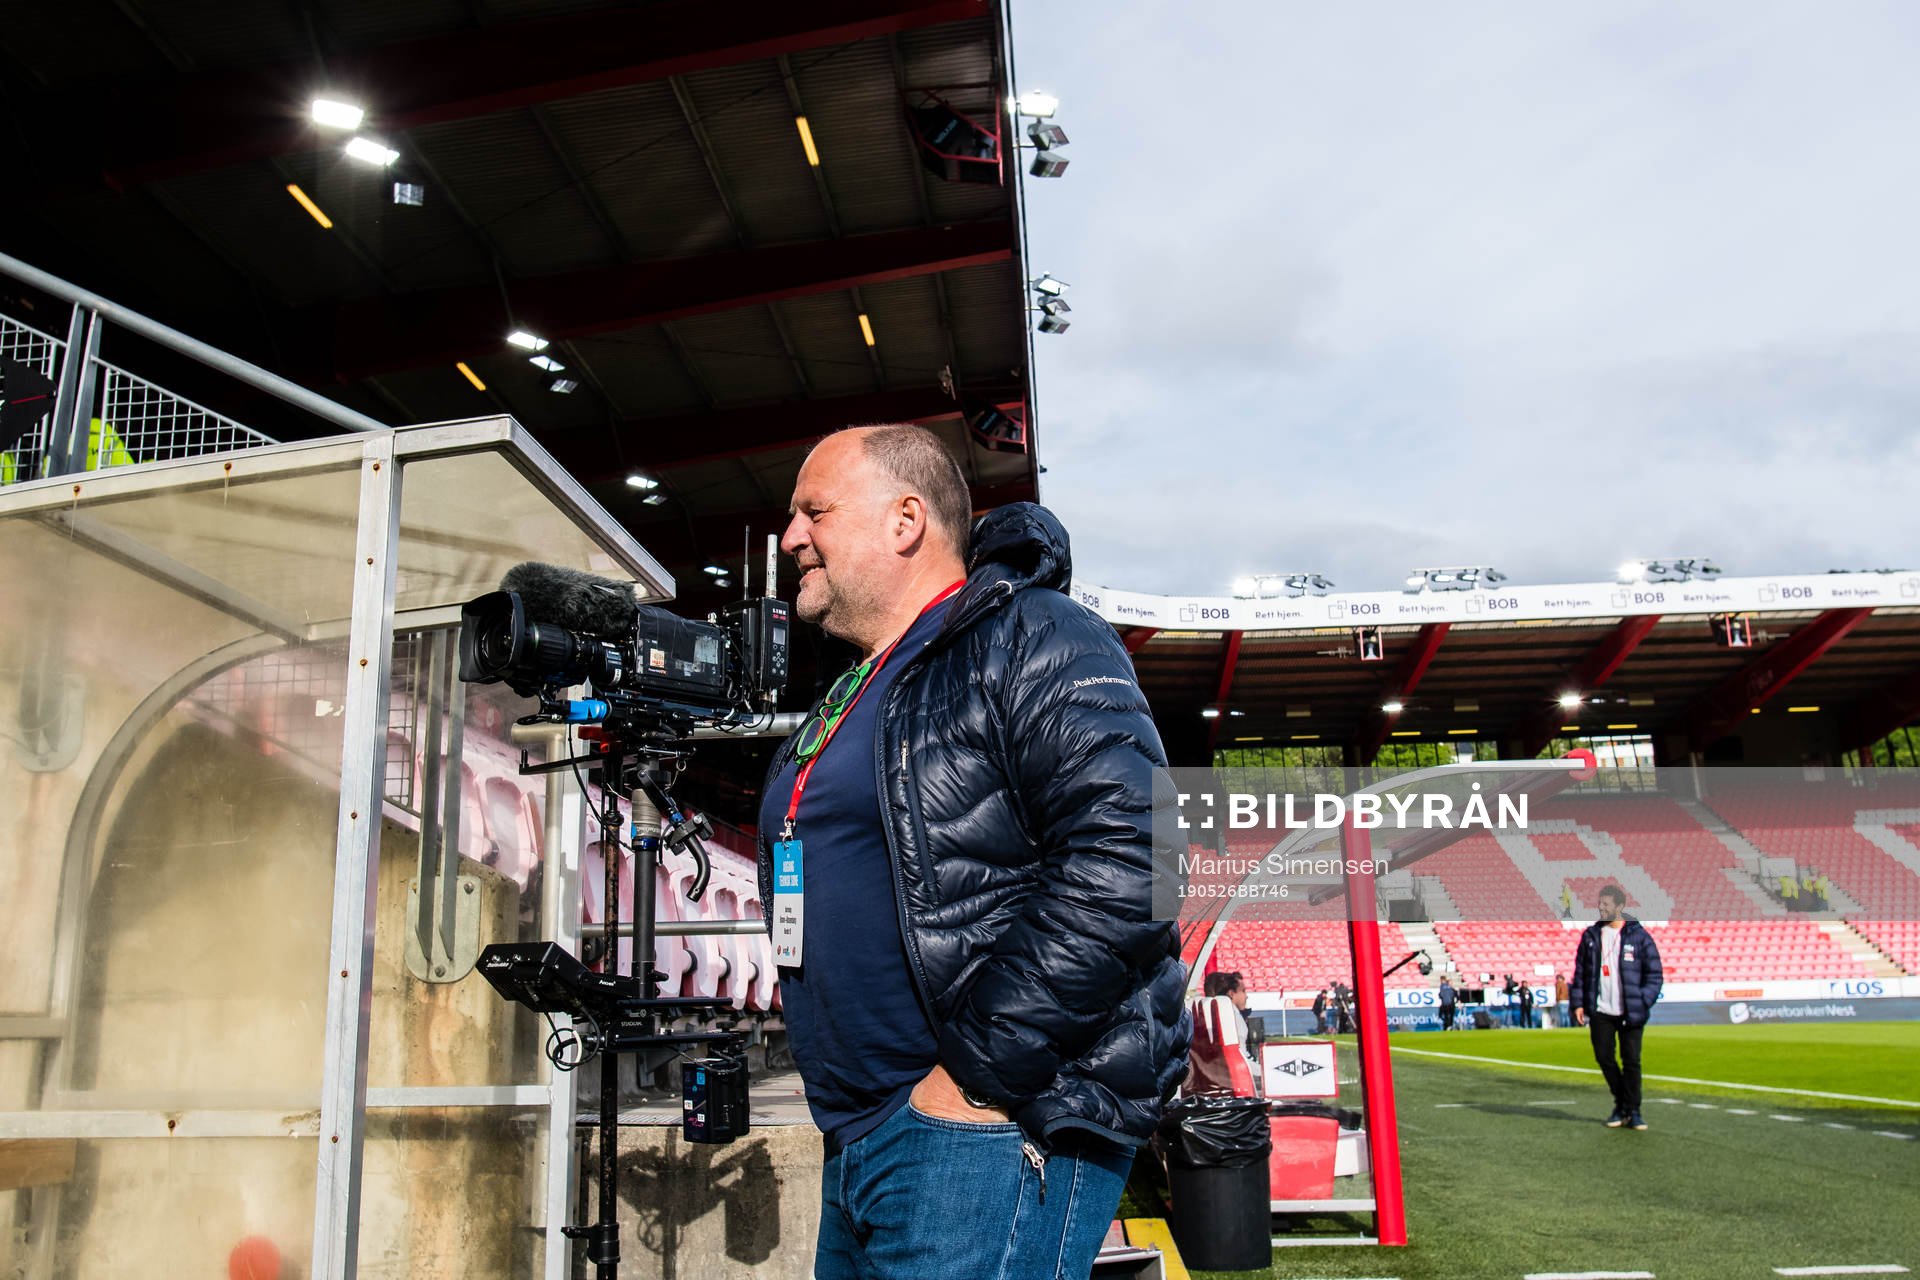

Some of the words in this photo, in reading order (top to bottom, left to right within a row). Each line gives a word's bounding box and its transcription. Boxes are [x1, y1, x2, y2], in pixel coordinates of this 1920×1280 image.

[1634, 592, 1665, 604] BOB
[1782, 586, 1813, 598] BOB
[1082, 592, 1099, 608] BOB
[1488, 598, 1518, 610] BOB
[1117, 605, 1134, 614] Rett
[1201, 607, 1230, 619] BOB
[1255, 611, 1275, 619] Rett
[1351, 603, 1381, 615] BOB
[1399, 605, 1417, 613] Rett
[1845, 981, 1884, 996] LOS
[1397, 990, 1435, 1005] LOS
